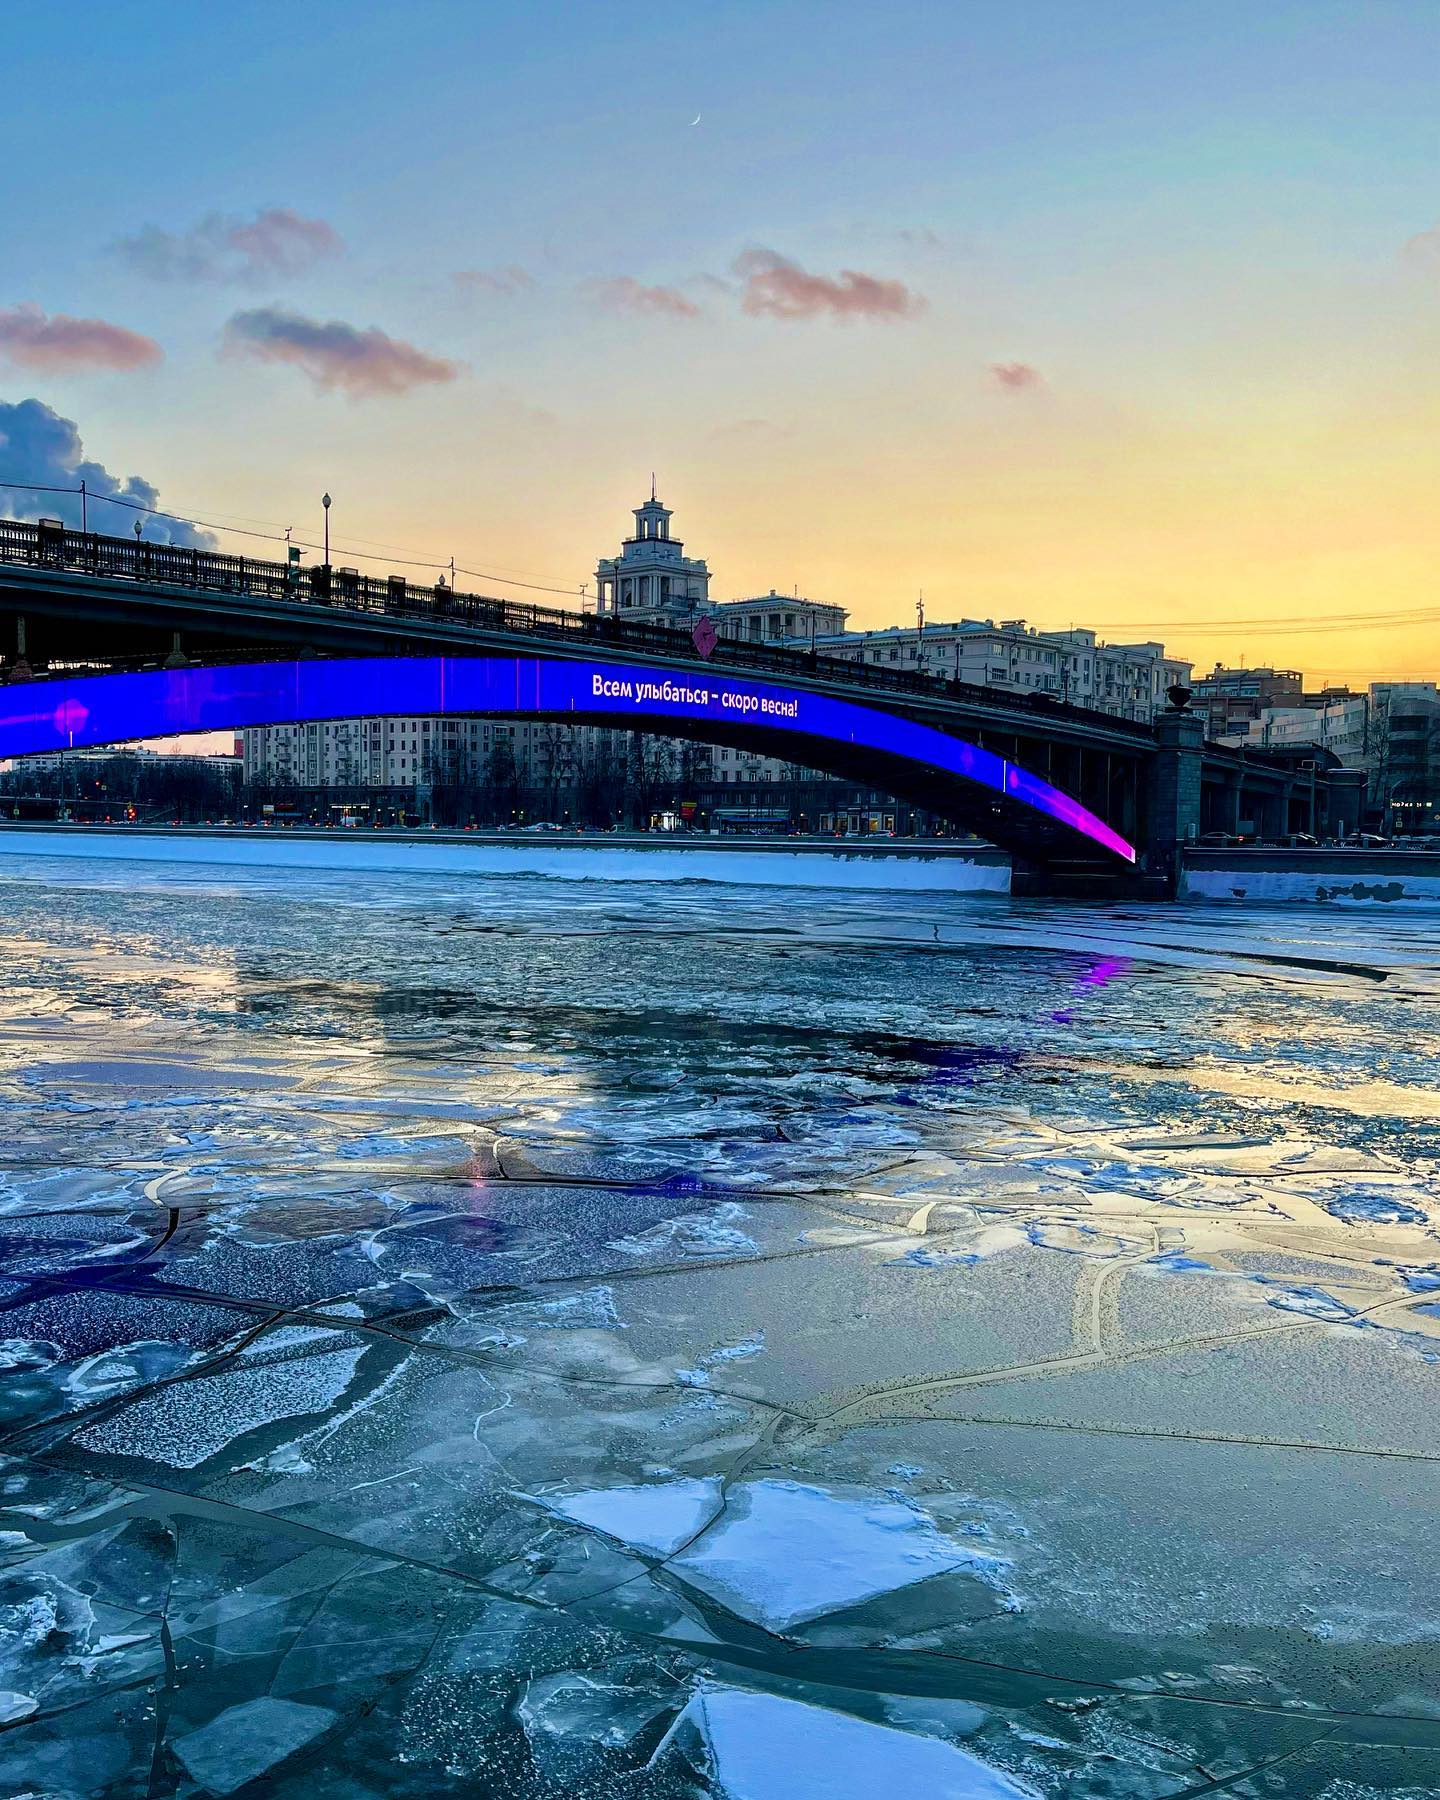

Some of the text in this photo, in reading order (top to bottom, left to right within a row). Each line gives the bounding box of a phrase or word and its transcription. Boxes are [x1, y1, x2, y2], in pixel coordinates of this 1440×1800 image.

[592, 674, 633, 698] Всем
[635, 680, 708, 704] улыбаться
[721, 692, 759, 713] скоро
[761, 699, 798, 717] весна!
